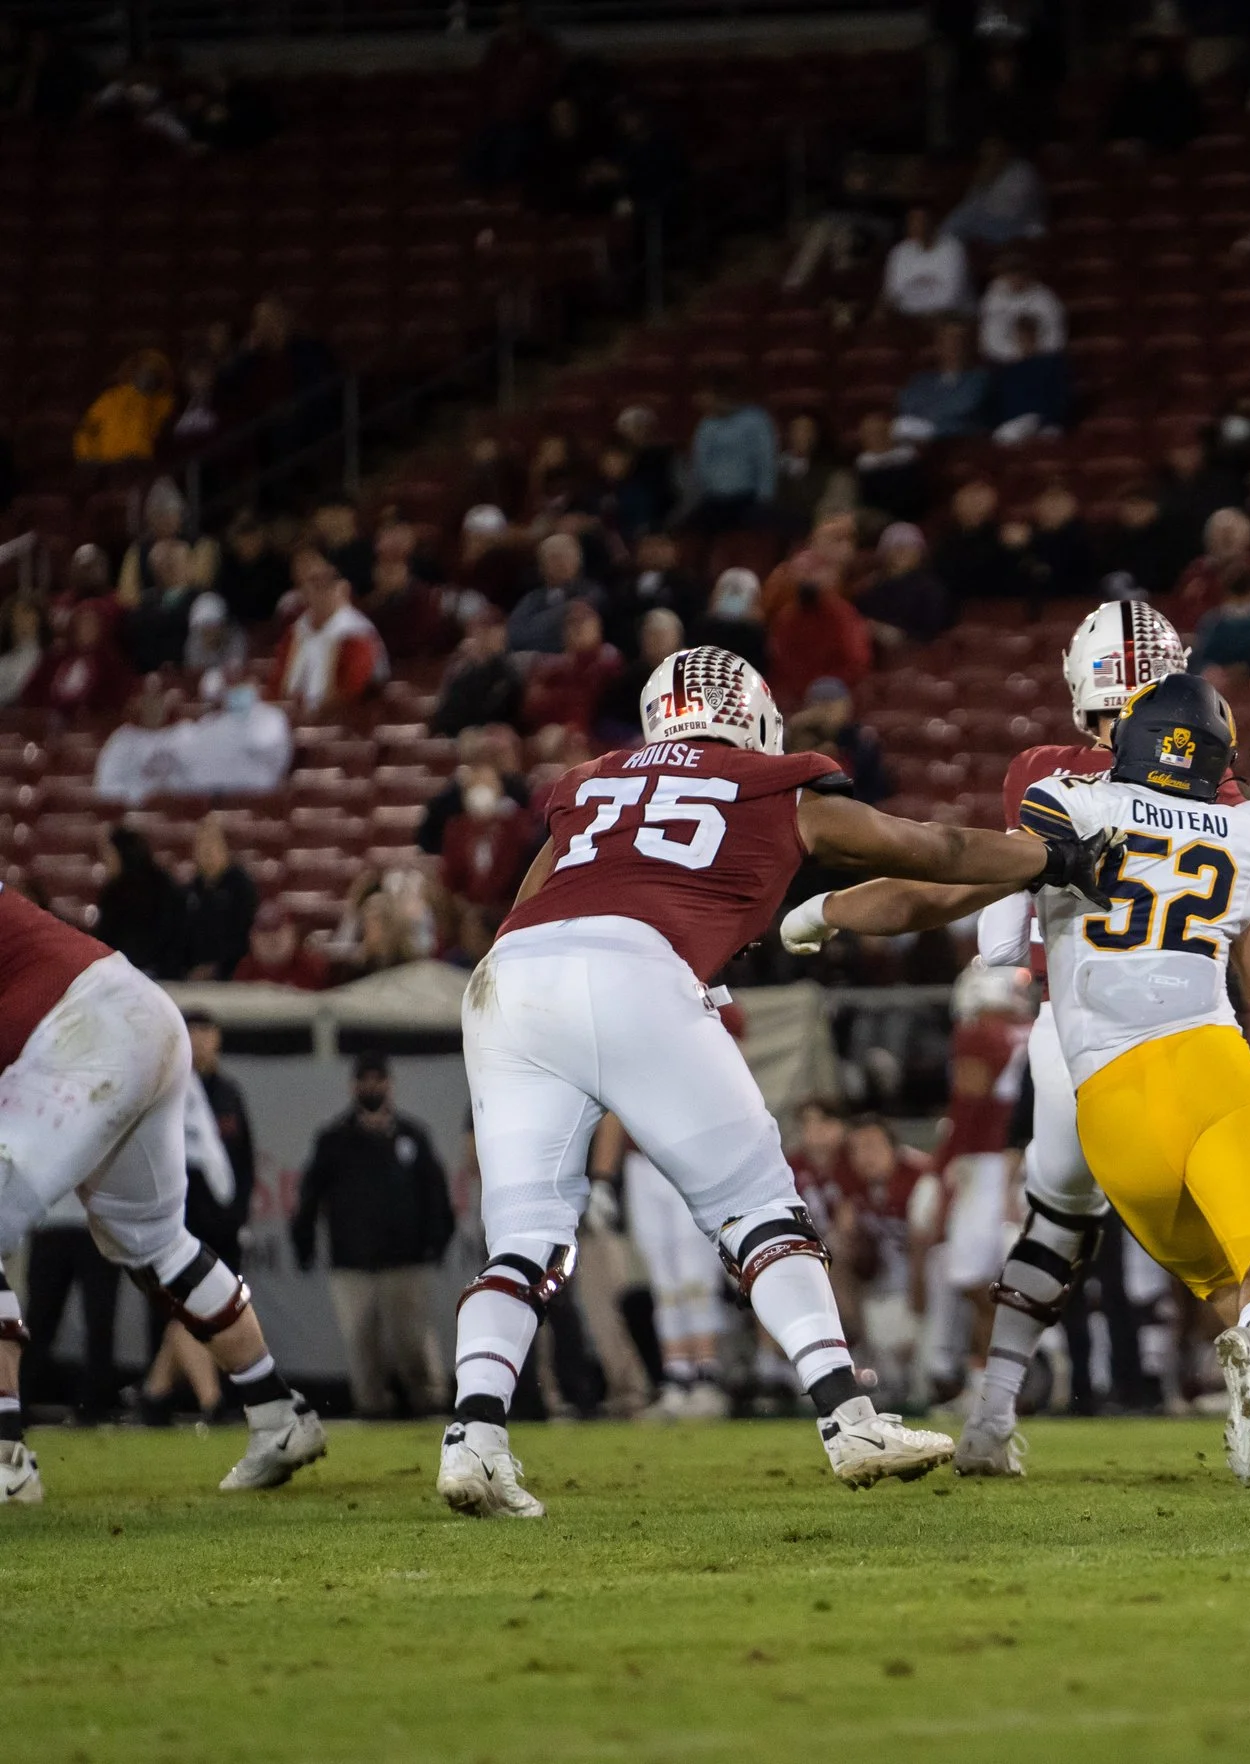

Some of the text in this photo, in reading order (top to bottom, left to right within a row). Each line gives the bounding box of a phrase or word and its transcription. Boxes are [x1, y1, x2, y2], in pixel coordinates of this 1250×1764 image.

[1115, 659, 1151, 684] 18
[660, 686, 704, 719] 75
[664, 720, 707, 738] STANFORD
[621, 742, 704, 769] ROUSE
[1162, 736, 1196, 759] 52
[1146, 770, 1191, 790] California
[554, 775, 740, 871] 75
[1132, 798, 1228, 839] CROTEAU
[1082, 829, 1239, 960] 52
